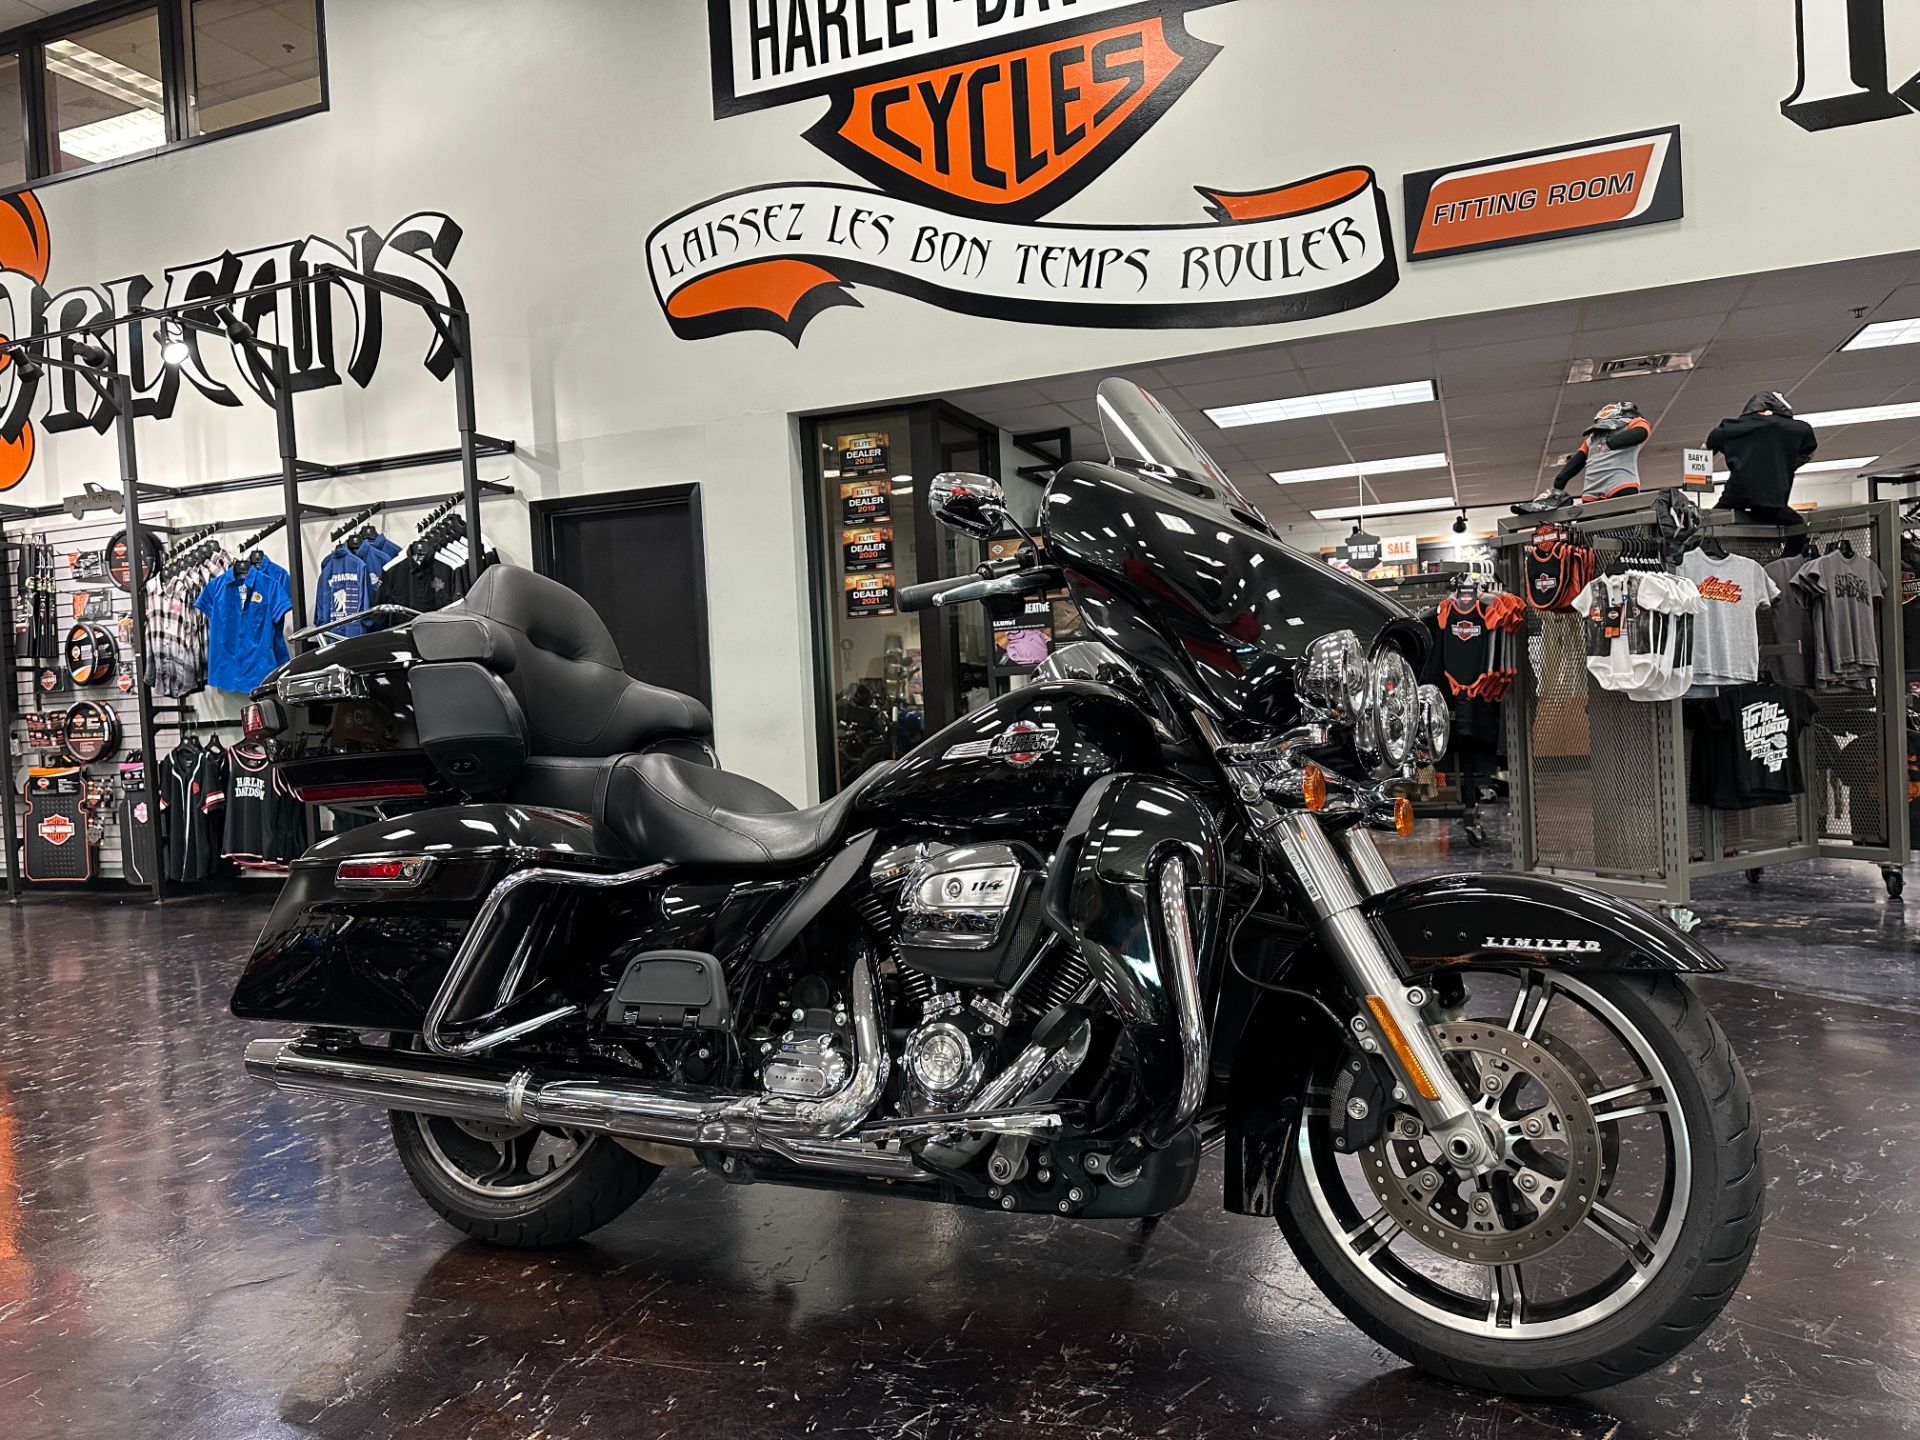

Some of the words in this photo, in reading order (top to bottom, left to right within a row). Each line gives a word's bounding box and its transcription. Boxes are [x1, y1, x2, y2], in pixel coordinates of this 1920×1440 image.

[869, 31, 1145, 191] CYCLES
[1432, 188, 1538, 227] FITTING
[1547, 171, 1636, 207] ROOM
[659, 203, 806, 279] LAISSEZ
[827, 204, 896, 256] LES
[909, 225, 993, 280] BON
[1015, 242, 1151, 292] TEMPS
[1179, 215, 1367, 291] ROULER
[853, 440, 873, 448] ELITE
[846, 448, 882, 459] DEALER
[1688, 453, 1703, 462] BABY
[855, 457, 874, 465] 2018
[1691, 463, 1706, 471] KIDS
[856, 488, 875, 496] ELITE
[848, 496, 884, 507] DEALER
[857, 505, 876, 513] 2019
[858, 534, 877, 542] ELITE
[850, 543, 886, 553] DEALER
[1387, 541, 1411, 555] SALE
[858, 551, 878, 559] 2020
[860, 581, 880, 589] ELITE
[852, 589, 888, 599] DEALER
[861, 597, 880, 605] 2021
[971, 880, 1004, 891] 114
[1482, 936, 1602, 953] LIMITED
